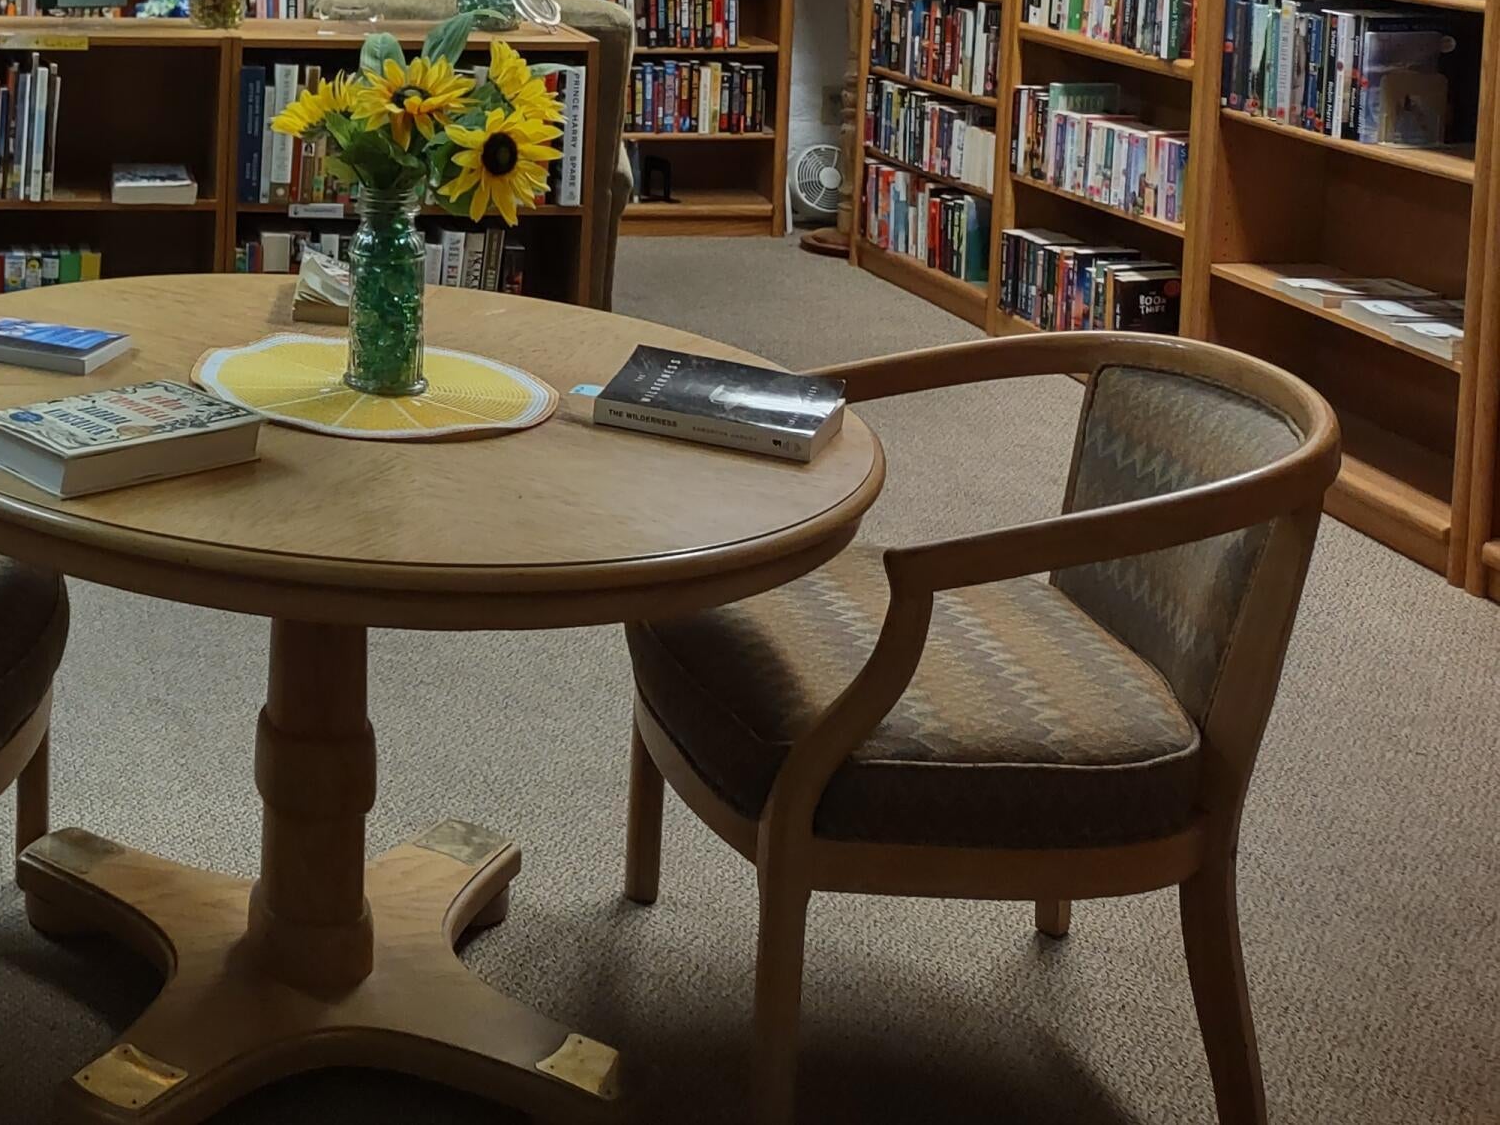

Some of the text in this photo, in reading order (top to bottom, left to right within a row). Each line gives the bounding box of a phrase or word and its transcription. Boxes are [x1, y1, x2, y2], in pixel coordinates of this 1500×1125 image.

[1325, 30, 1337, 129] Shelter Robin Merrill
[568, 73, 580, 188] PRINCE HARRY SPARE
[448, 238, 461, 262] ME
[641, 359, 681, 402] WILDERNESS
[608, 409, 678, 428] THE WILDERNESS
